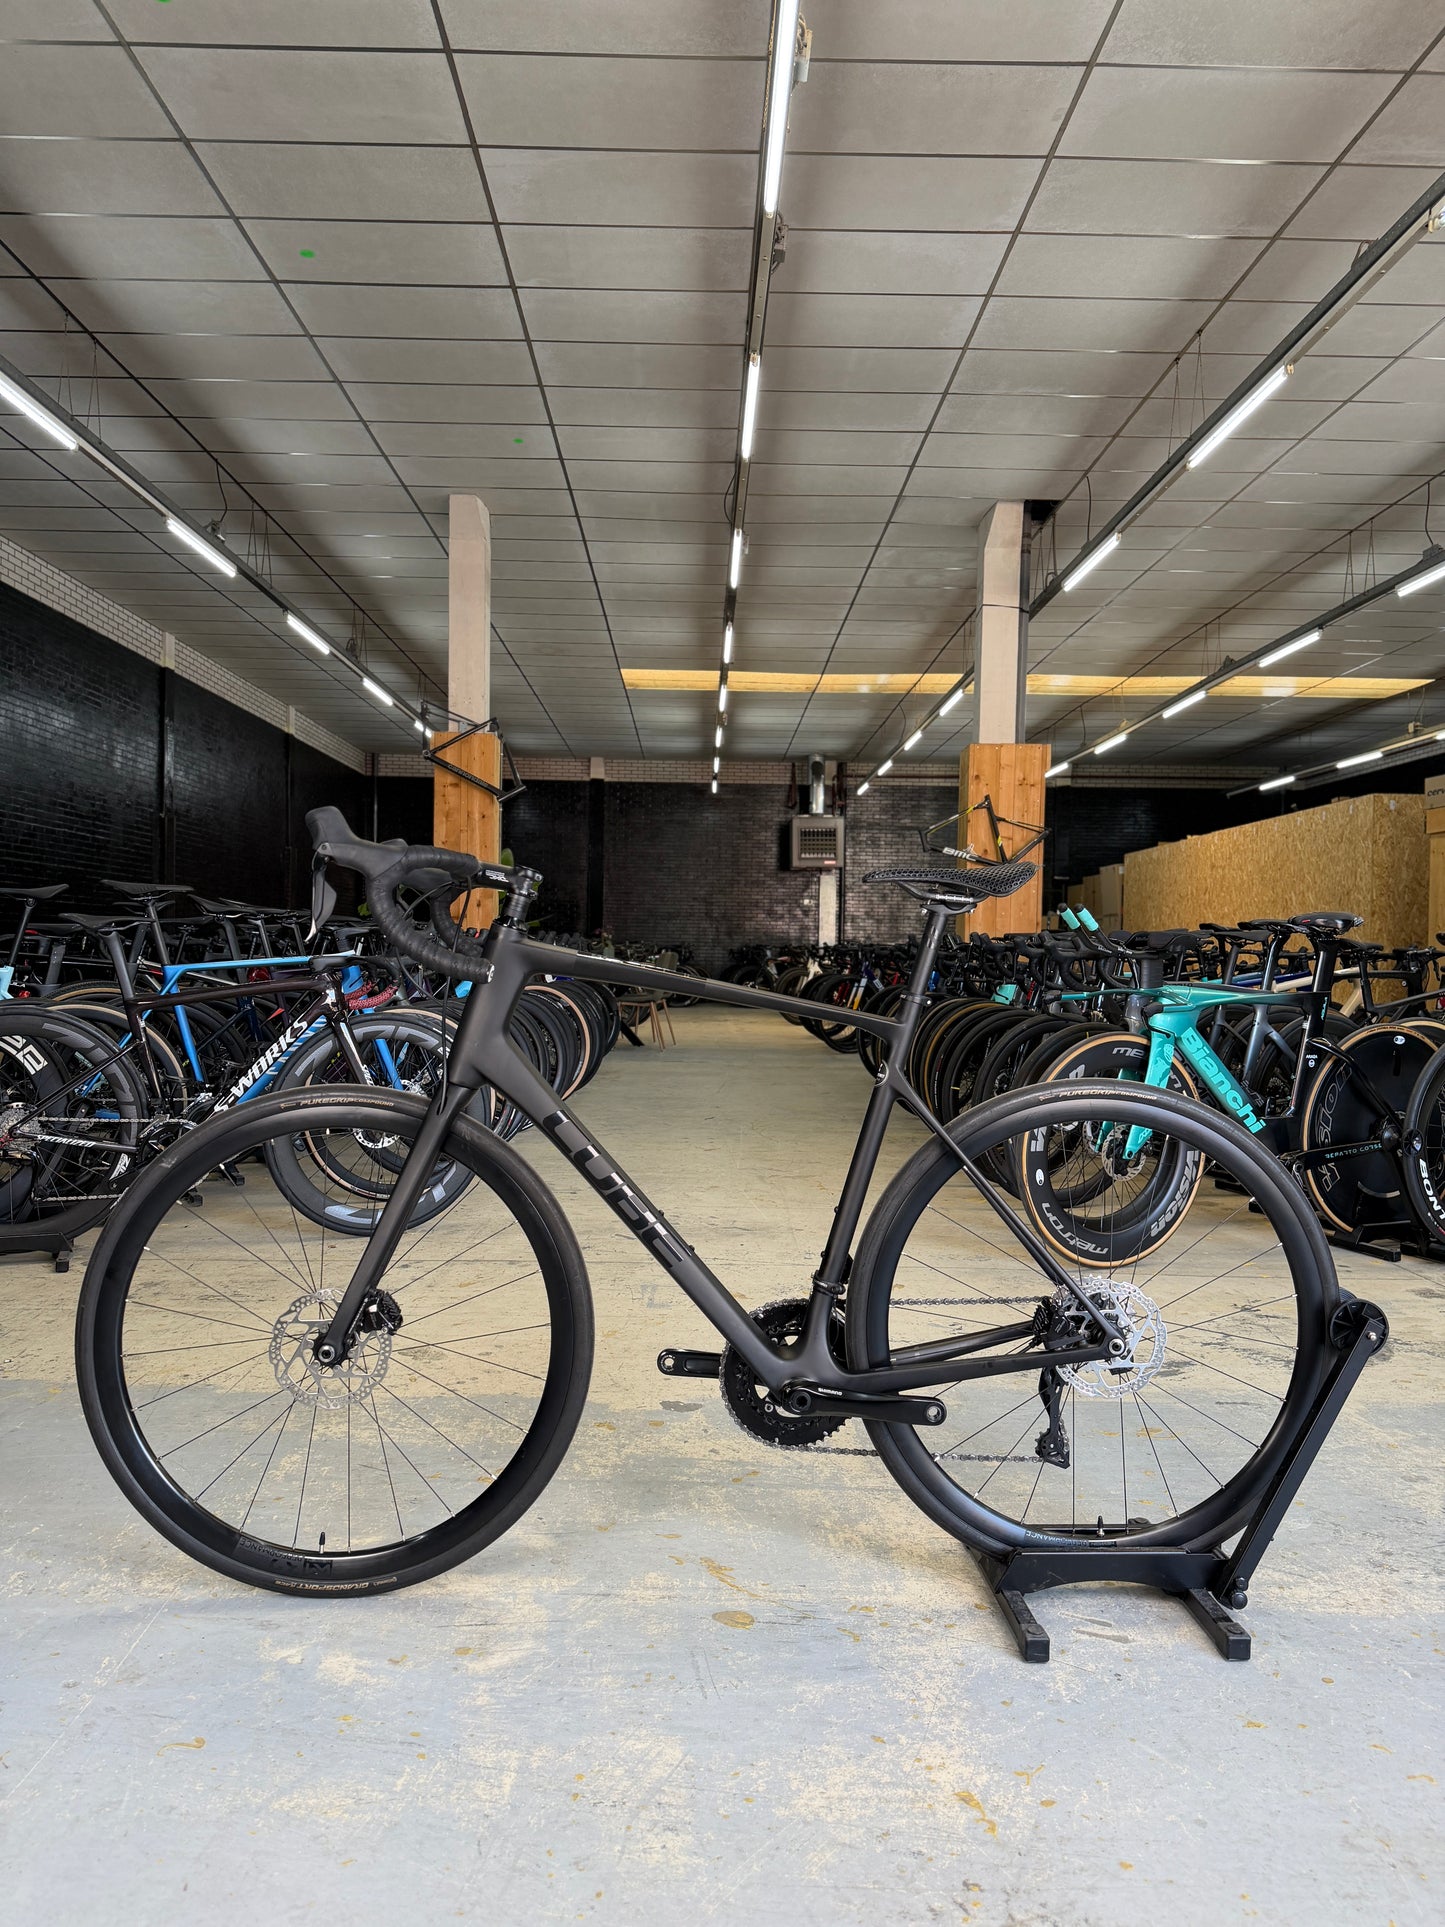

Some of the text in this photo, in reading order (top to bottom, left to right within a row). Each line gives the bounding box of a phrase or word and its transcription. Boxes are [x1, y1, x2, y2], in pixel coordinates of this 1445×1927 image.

[942, 847, 978, 861] BMC
[214, 1020, 308, 1112] S-WORKS
[1181, 1027, 1267, 1134] Bianchi
[37, 1134, 97, 1148] SPECIALIZED
[543, 1110, 692, 1268] CUBE
